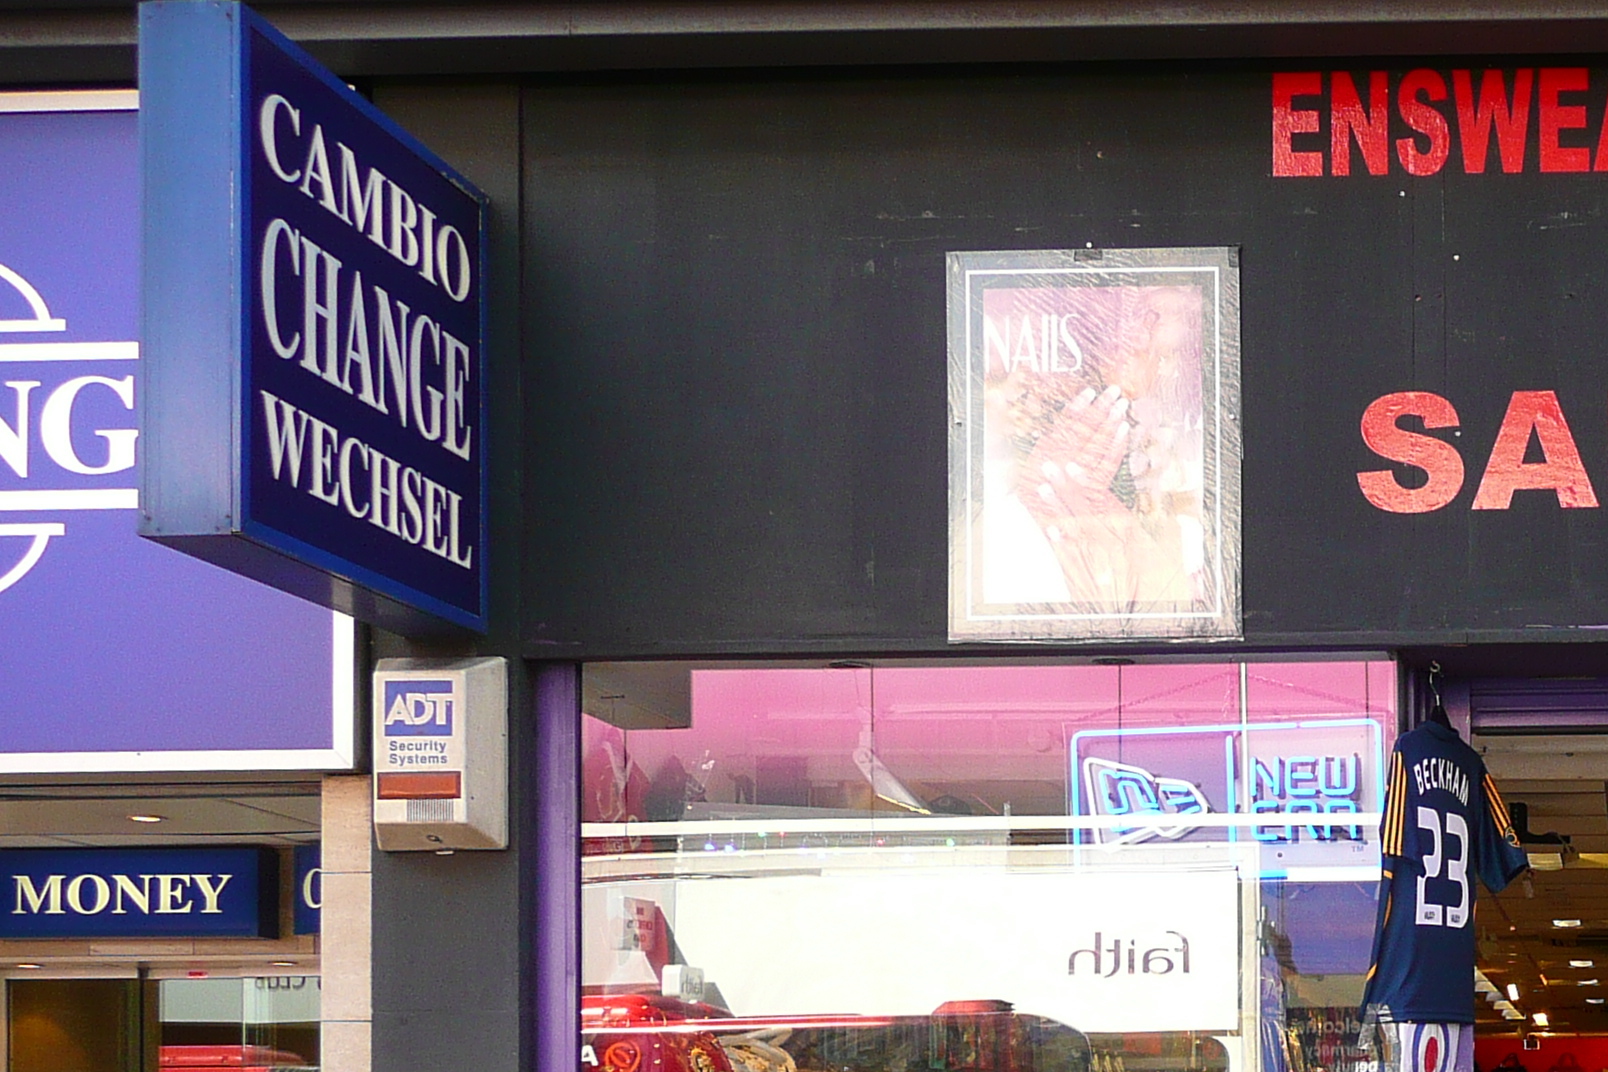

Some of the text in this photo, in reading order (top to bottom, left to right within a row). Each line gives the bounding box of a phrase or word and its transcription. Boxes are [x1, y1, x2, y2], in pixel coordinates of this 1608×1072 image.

[259, 93, 471, 303] CAMBIO
[260, 217, 471, 462] CHANGE
[983, 313, 1082, 374] NAILS
[260, 390, 472, 570] WECHSEL
[384, 692, 452, 726] ADT
[388, 752, 448, 766] Systems
[389, 740, 447, 754] Security
[1250, 755, 1357, 798] NEW
[1413, 757, 1470, 807] BECKHAM
[1250, 799, 1358, 842] ERA
[1415, 805, 1469, 929] 23
[11, 873, 233, 915] MONEY
